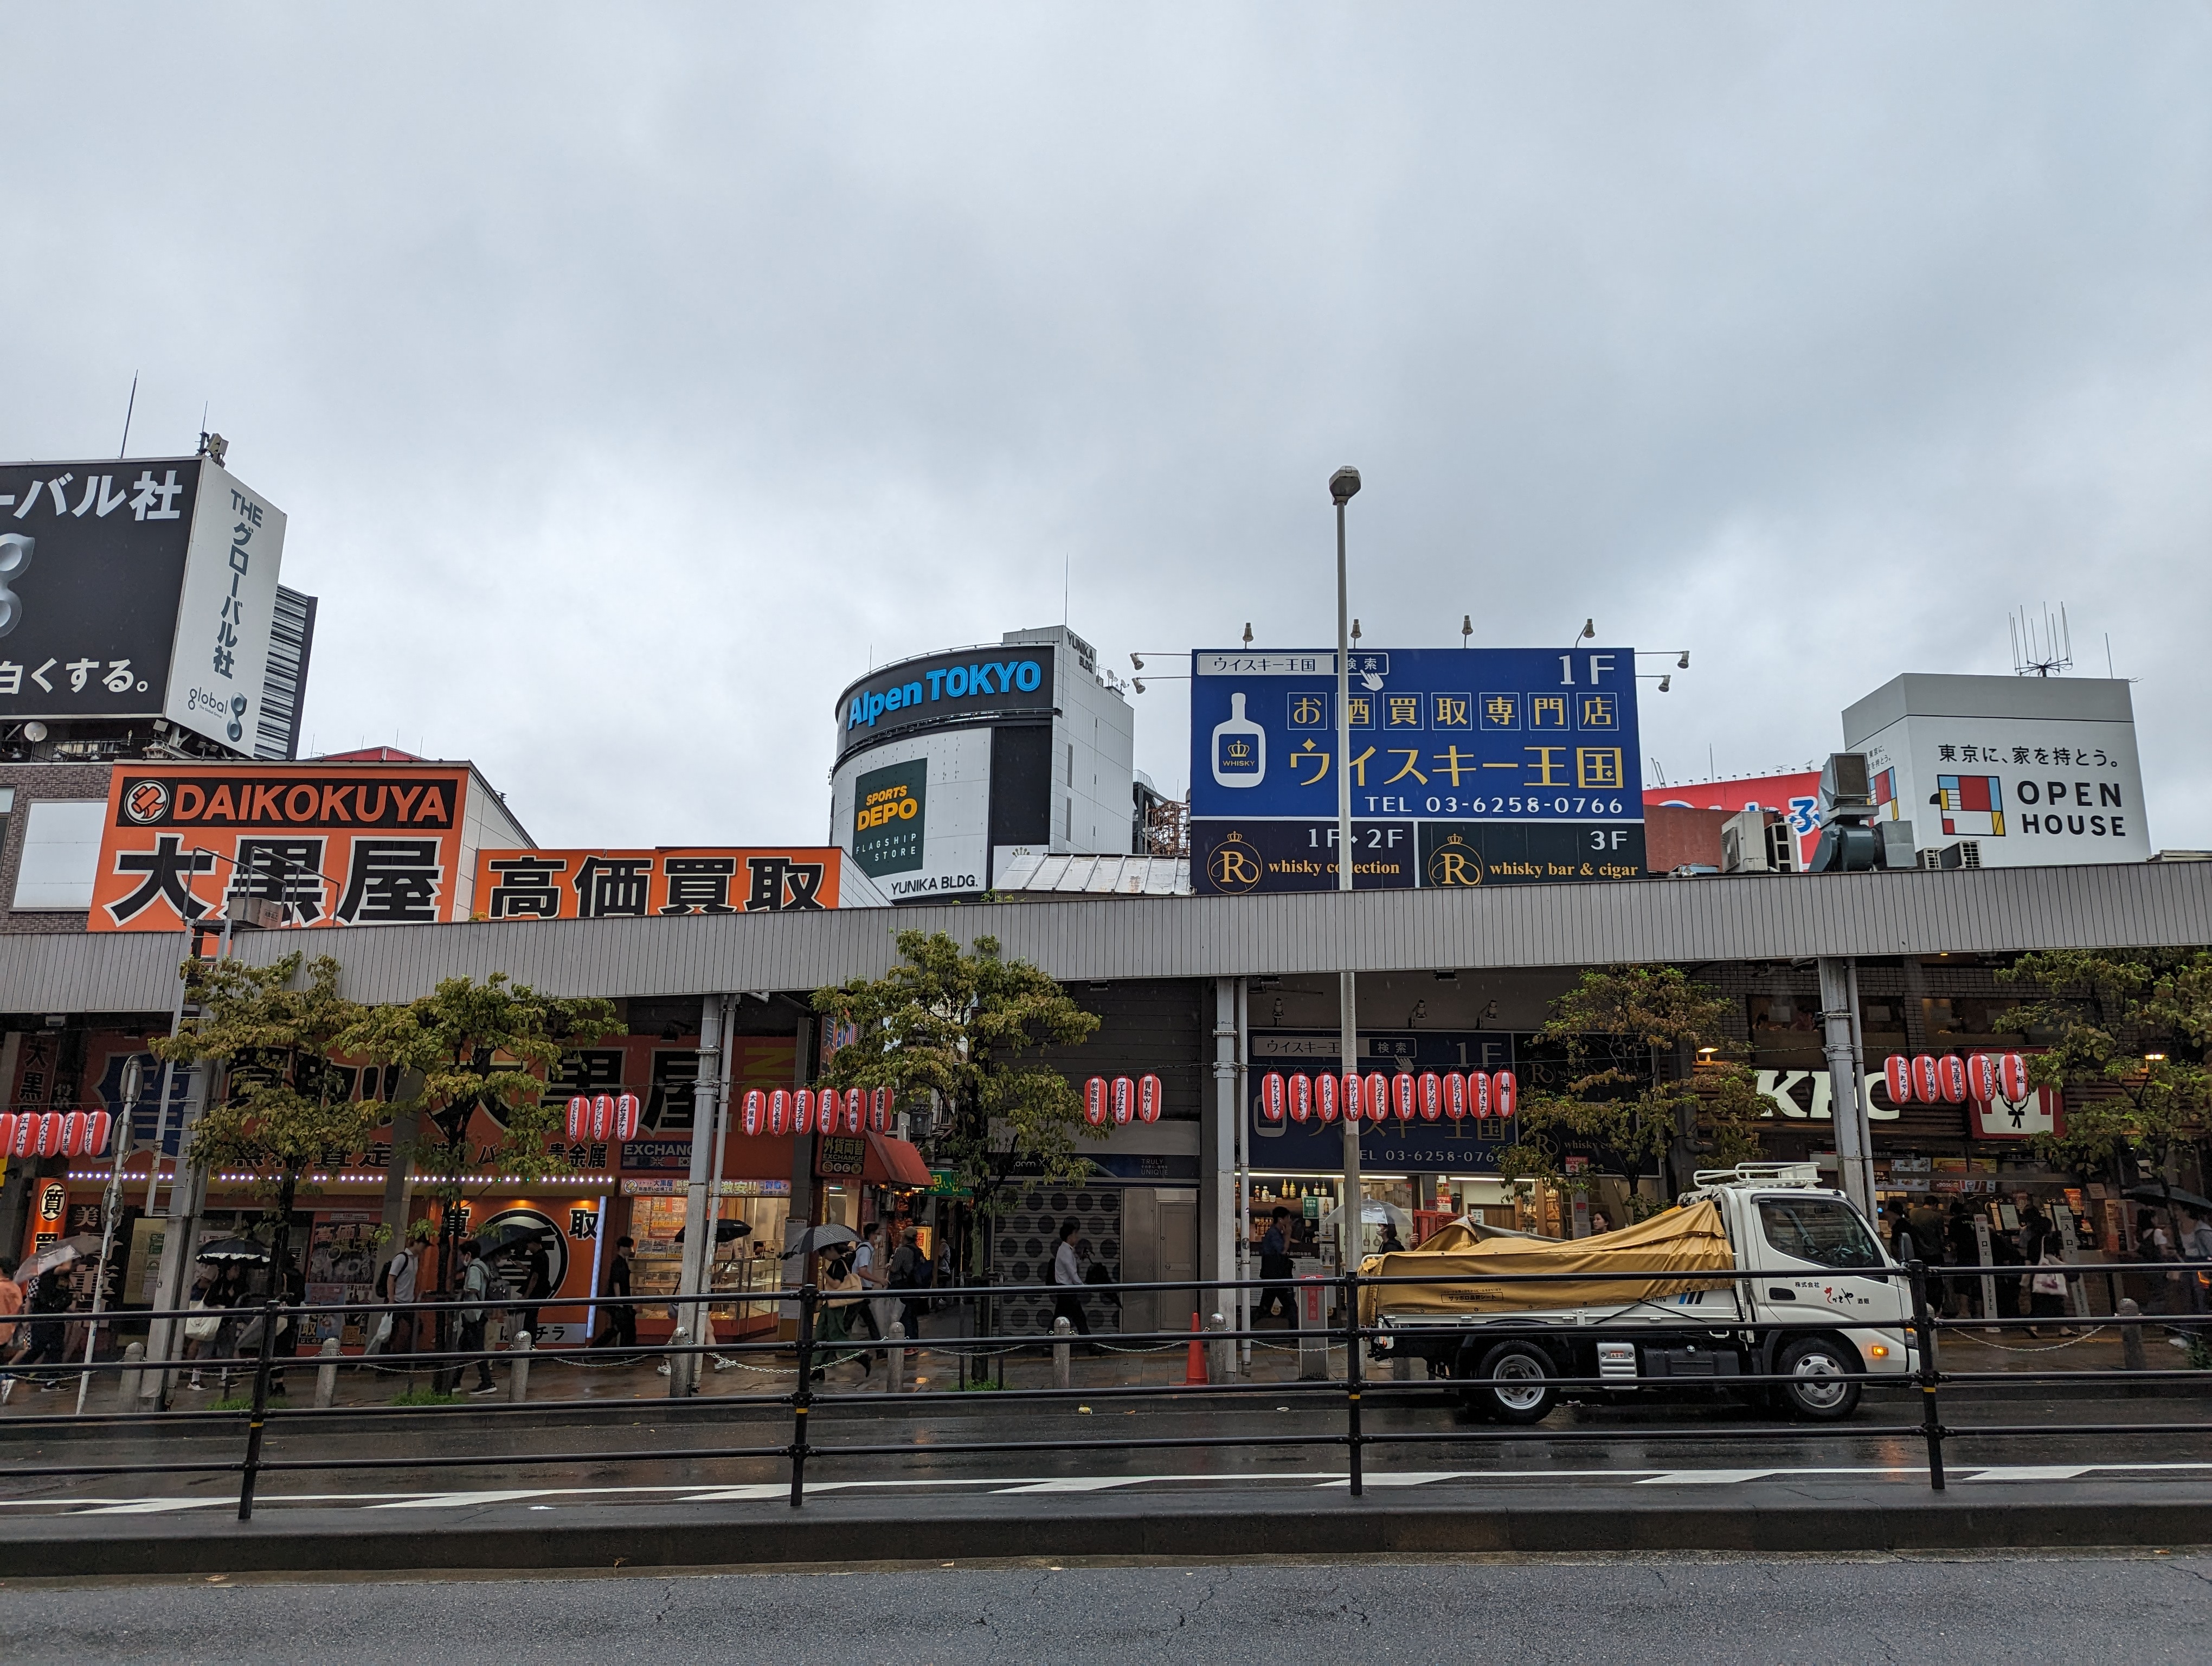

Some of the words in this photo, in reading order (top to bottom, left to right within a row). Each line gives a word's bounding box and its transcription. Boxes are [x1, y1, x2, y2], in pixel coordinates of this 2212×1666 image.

[0, 470, 183, 521] バル社
[230, 488, 263, 529] THE
[213, 521, 254, 680] グローバル社
[1066, 631, 1094, 663] YUNIKA
[1213, 657, 1316, 672] ウイスキー王国
[188, 687, 228, 714] global
[847, 680, 923, 731] Alpen
[926, 660, 1041, 701] TOKYO
[1290, 738, 1624, 789] ウイスキー王国
[1938, 744, 2119, 768] 東京に、家を持とう。
[173, 784, 447, 823] DAIKOKUYA
[866, 785, 908, 806] SPORTS
[1365, 796, 1412, 813] TEL
[1425, 797, 1624, 815] 03-6258-0766
[2017, 780, 2123, 808] OPEN
[857, 798, 918, 831] DEPO
[2022, 814, 2126, 837] HOUSE
[856, 832, 917, 855] FLAGSHIP
[874, 845, 916, 862] STORE
[1591, 831, 1628, 850] 3F
[103, 832, 444, 927] 大黒屋
[891, 876, 938, 895] YUNIKA
[941, 874, 978, 889] BLDG.
[1268, 861, 1321, 876] whisky
[1489, 862, 1543, 879] whisky
[1548, 863, 1575, 876] bar
[1580, 863, 1594, 876] &
[1599, 862, 1638, 880] cigar
[488, 855, 826, 920] 高価買取
[1267, 1040, 1341, 1054] ウイスキー王
[1378, 1041, 1406, 1053] 検索
[1898, 1059, 1908, 1098] たっちゃん
[821, 1093, 832, 1126] てらだ屋
[850, 1095, 859, 1125] 大黒屋
[1090, 1081, 1098, 1118] 新宿取引所
[1116, 1081, 1126, 1122] マルトクチケット
[1324, 1079, 1332, 1116] インターバンク
[1478, 1078, 1487, 1114] まゆきち
[16, 1117, 29, 1150] 江戸小町
[62, 1116, 74, 1151] ウイスキー王国
[619, 1099, 629, 1139] アクセスチケット
[823, 1154, 863, 1162] EXCHANGE
[824, 1137, 865, 1155] 外貨両替
